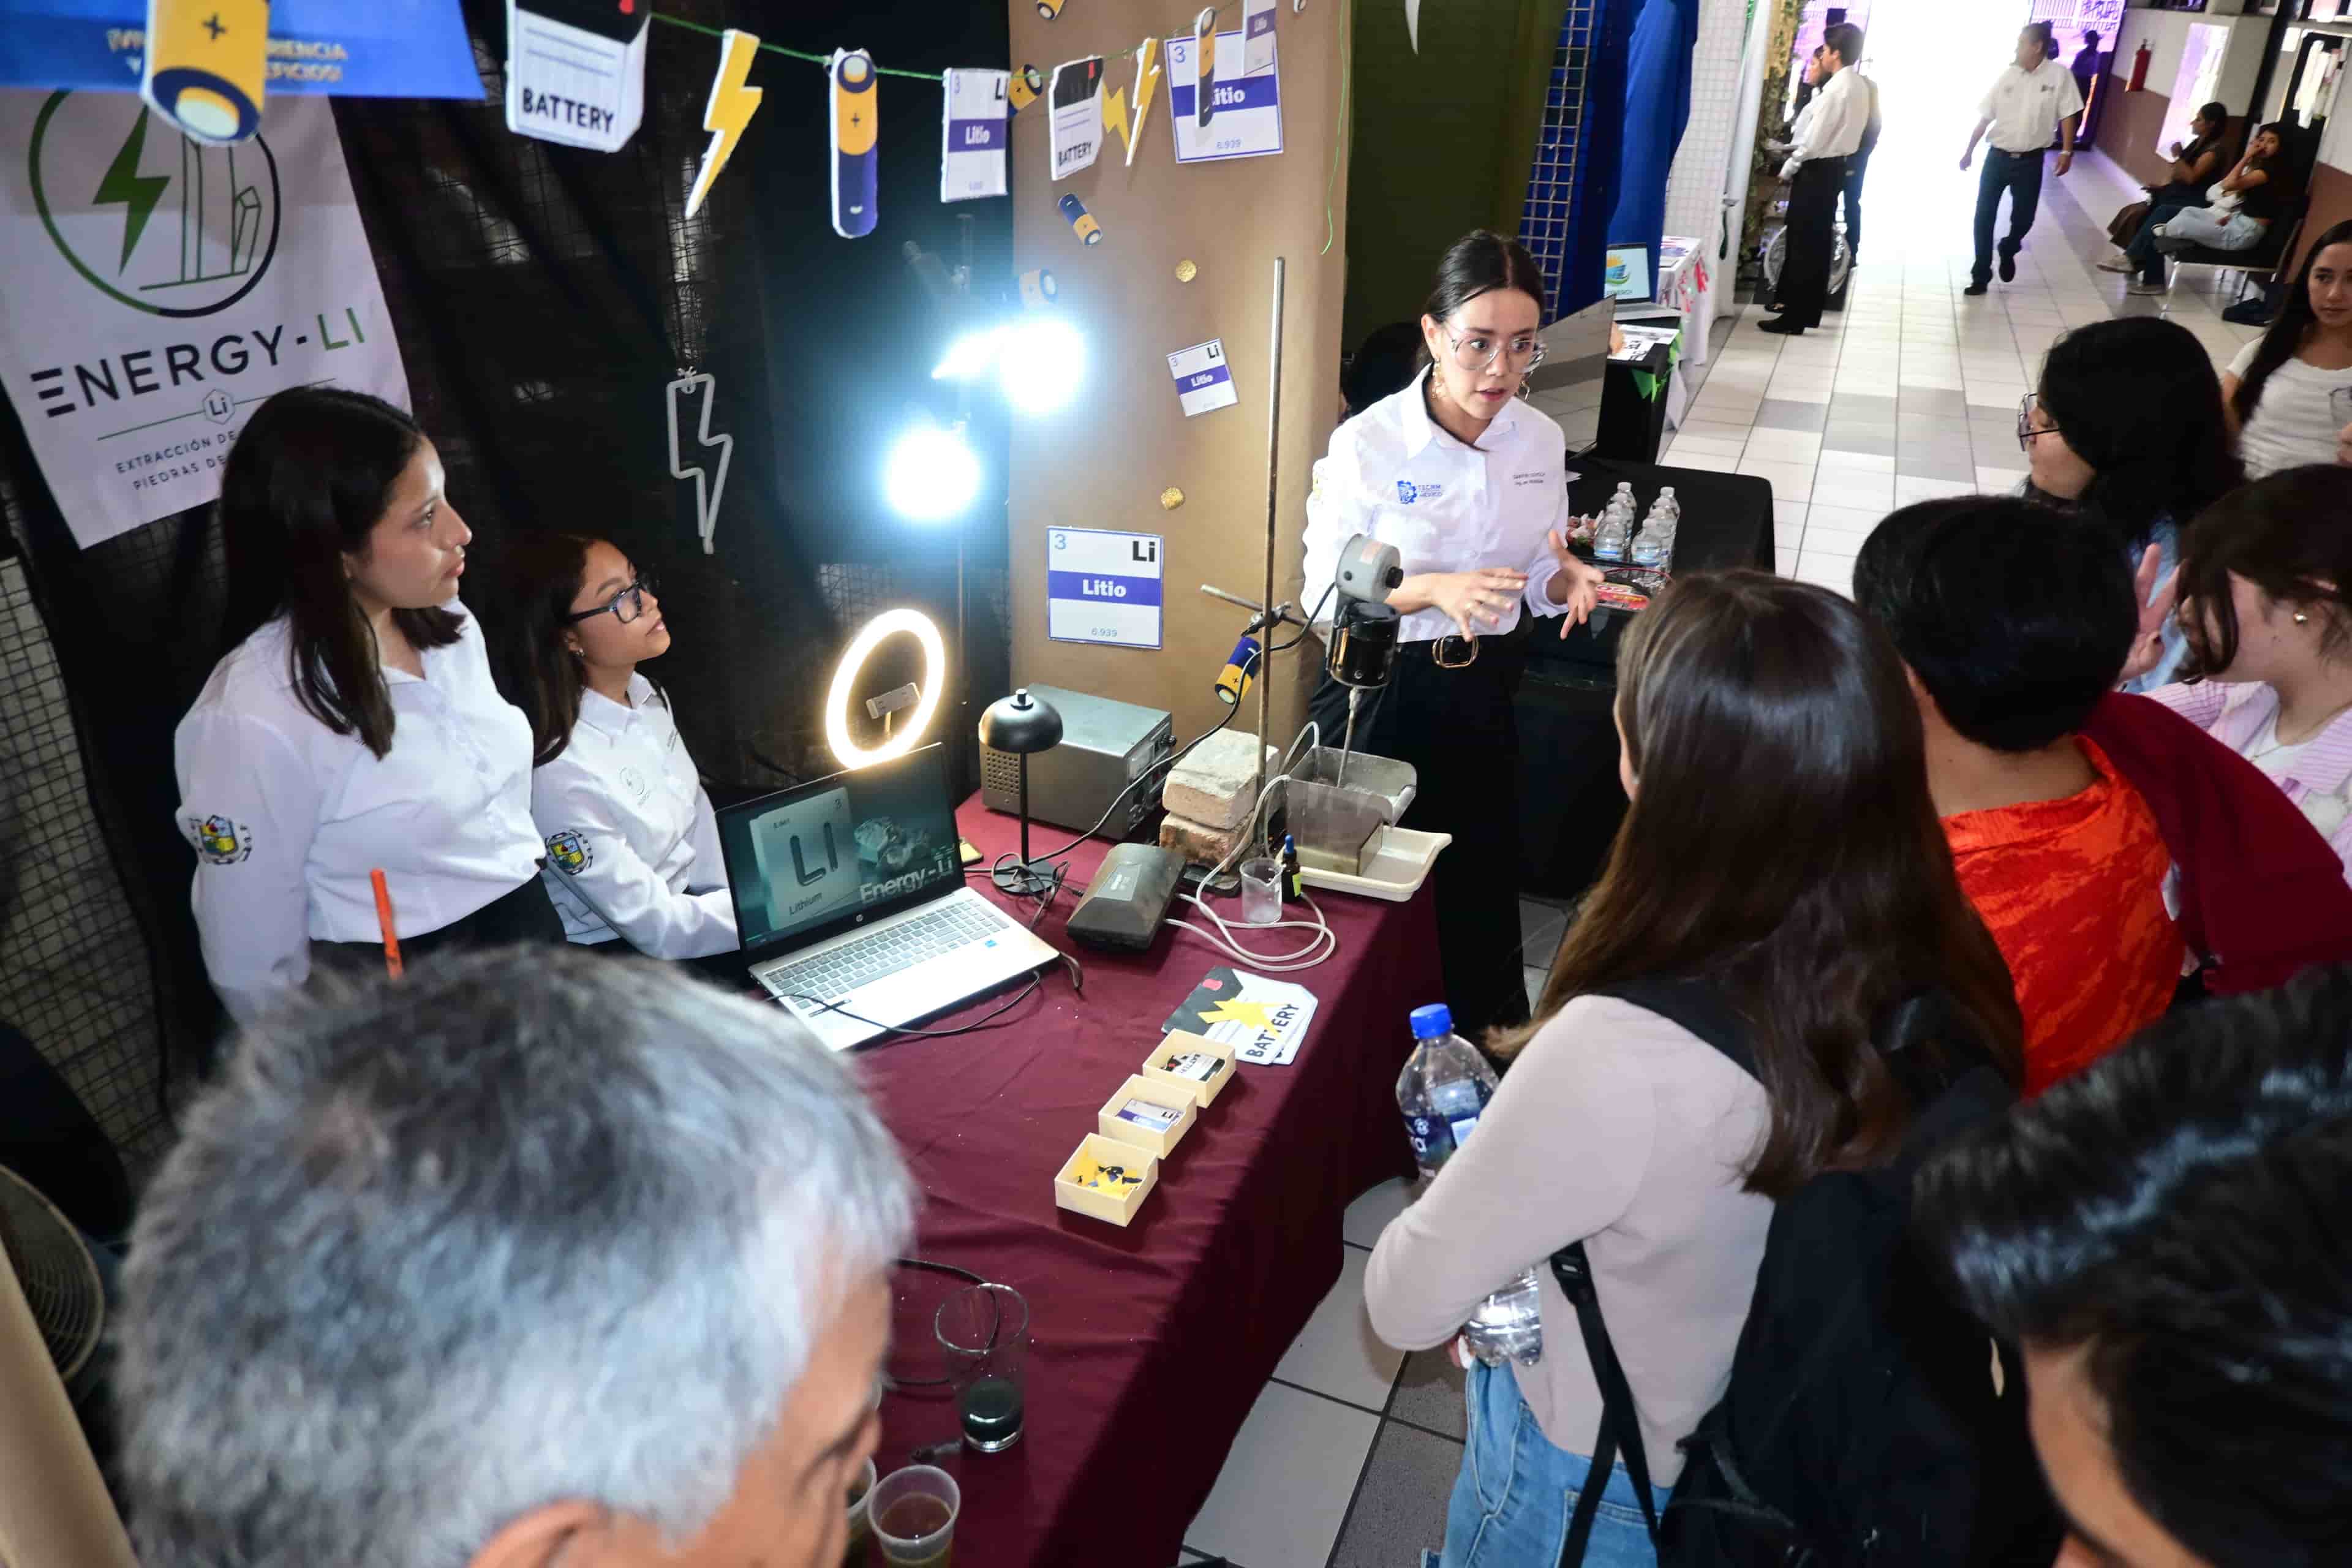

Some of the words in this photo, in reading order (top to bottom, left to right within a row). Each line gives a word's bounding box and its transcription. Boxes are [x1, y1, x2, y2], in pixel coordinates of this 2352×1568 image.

[1174, 46, 1186, 63] 3
[1213, 86, 1245, 106] itio
[522, 88, 613, 132] BATTERY
[965, 126, 990, 145] Litio
[1058, 141, 1091, 167] BATTERY
[1207, 344, 1220, 359] Li
[209, 397, 227, 416] Li
[116, 437, 211, 473] EXTRACCIÓN
[217, 431, 236, 444] DE
[133, 463, 200, 489] PIEDRAS
[1054, 533, 1066, 550] 3
[1133, 541, 1156, 562] Li
[1082, 579, 1126, 598] Litio
[1091, 627, 1118, 638] 6.939
[789, 892, 823, 916] Lithium
[1245, 1004, 1299, 1058] BATERY
